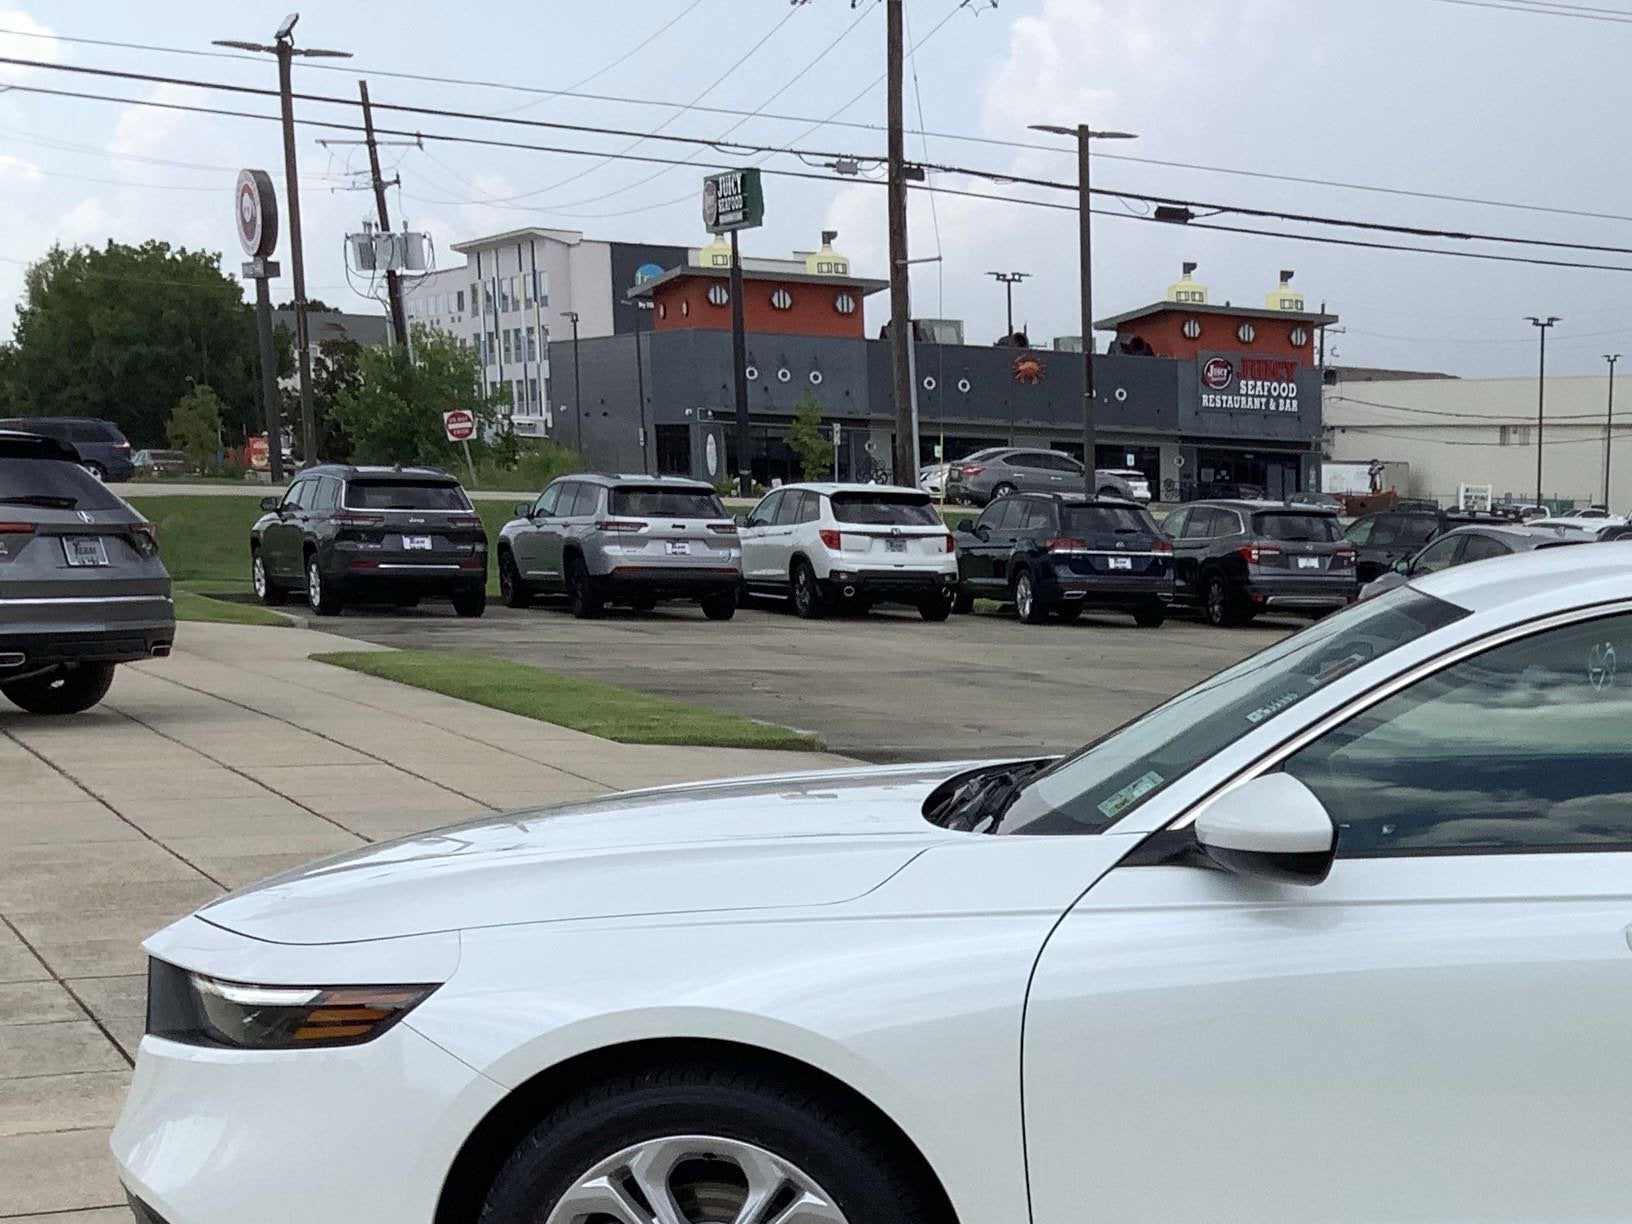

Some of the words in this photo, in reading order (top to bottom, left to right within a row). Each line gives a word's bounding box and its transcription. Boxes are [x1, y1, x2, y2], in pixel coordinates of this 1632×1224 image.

[718, 172, 742, 197] JUICY
[1237, 359, 1297, 382] JUICY
[1240, 380, 1297, 397] SEAFOOD
[1202, 394, 1266, 410] RESTAURANT
[1269, 398, 1277, 410] &
[1279, 399, 1299, 412] BAR
